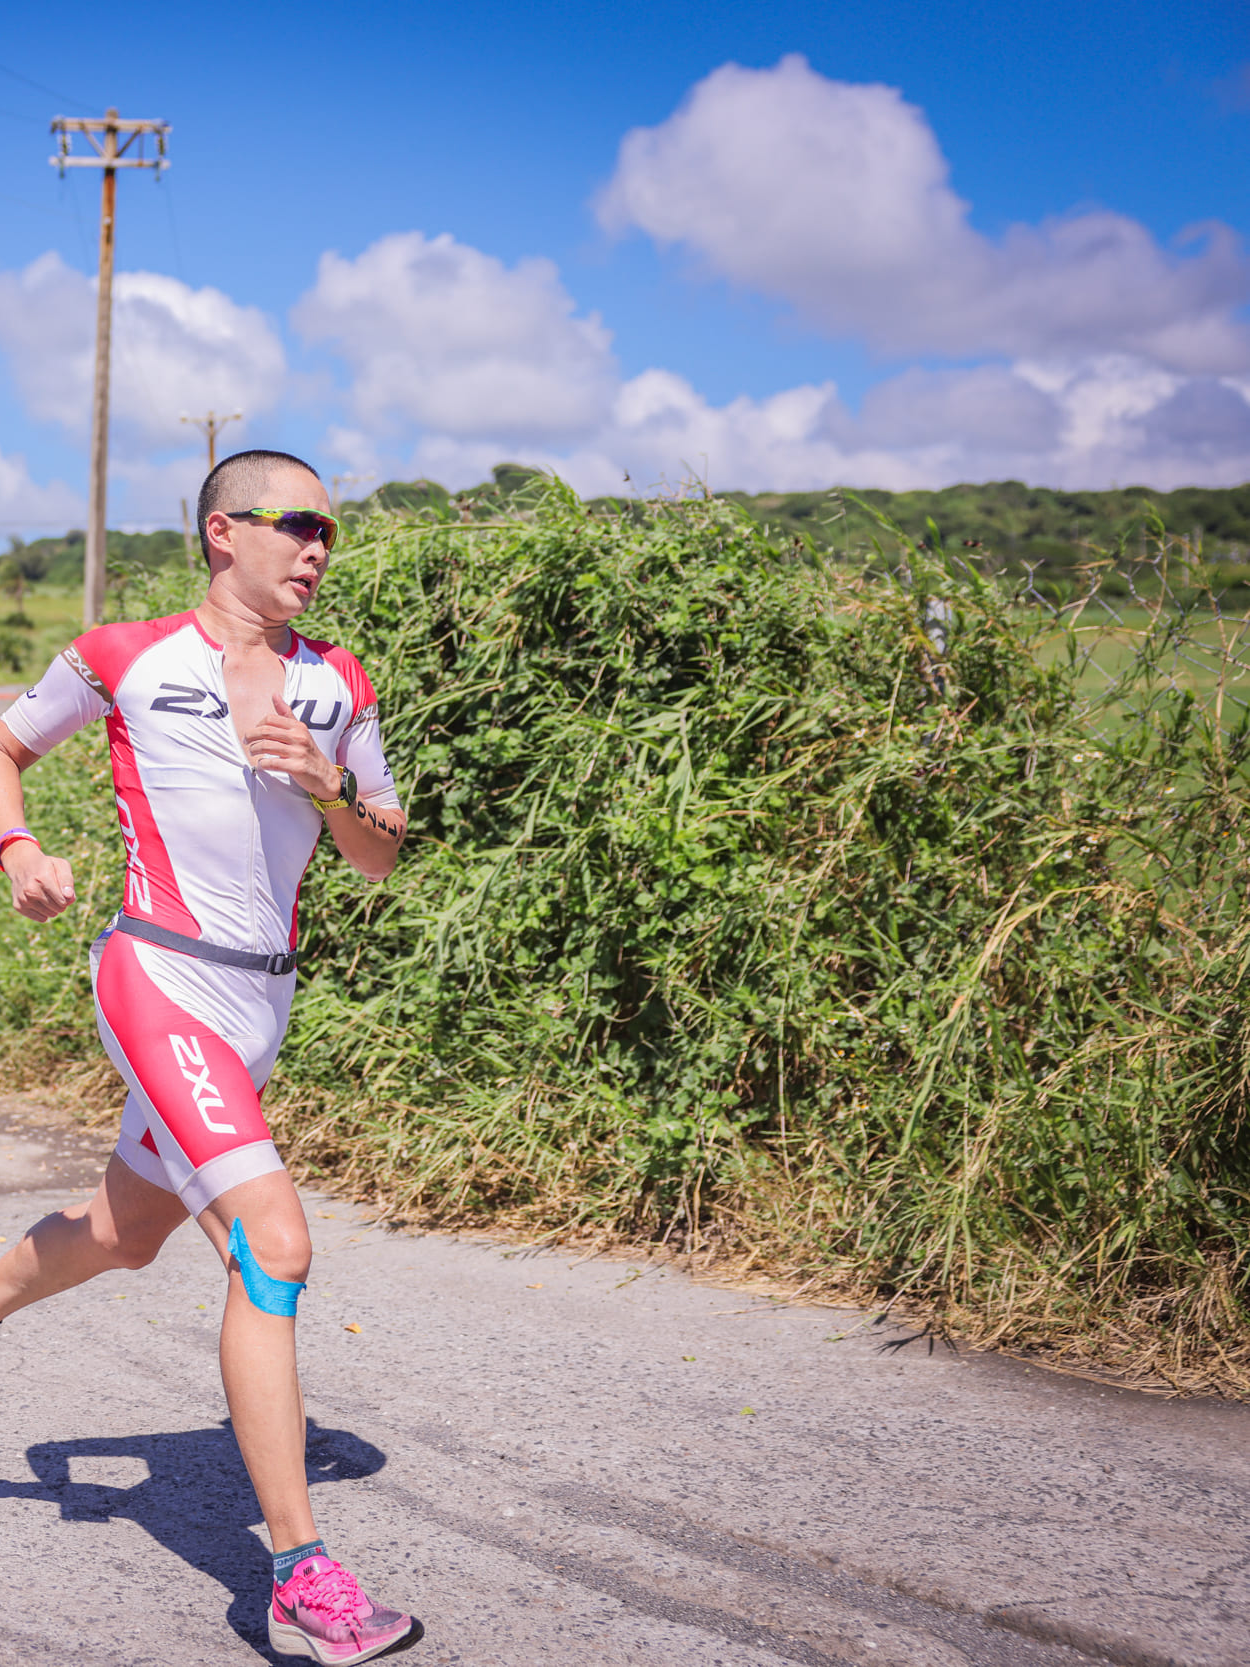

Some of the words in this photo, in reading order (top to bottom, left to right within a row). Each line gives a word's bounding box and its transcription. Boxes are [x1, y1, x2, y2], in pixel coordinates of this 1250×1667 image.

[63, 646, 102, 687] 2XU
[116, 792, 153, 915] 2XU
[168, 1034, 237, 1134] 2XU
[303, 1565, 316, 1577] NIK
